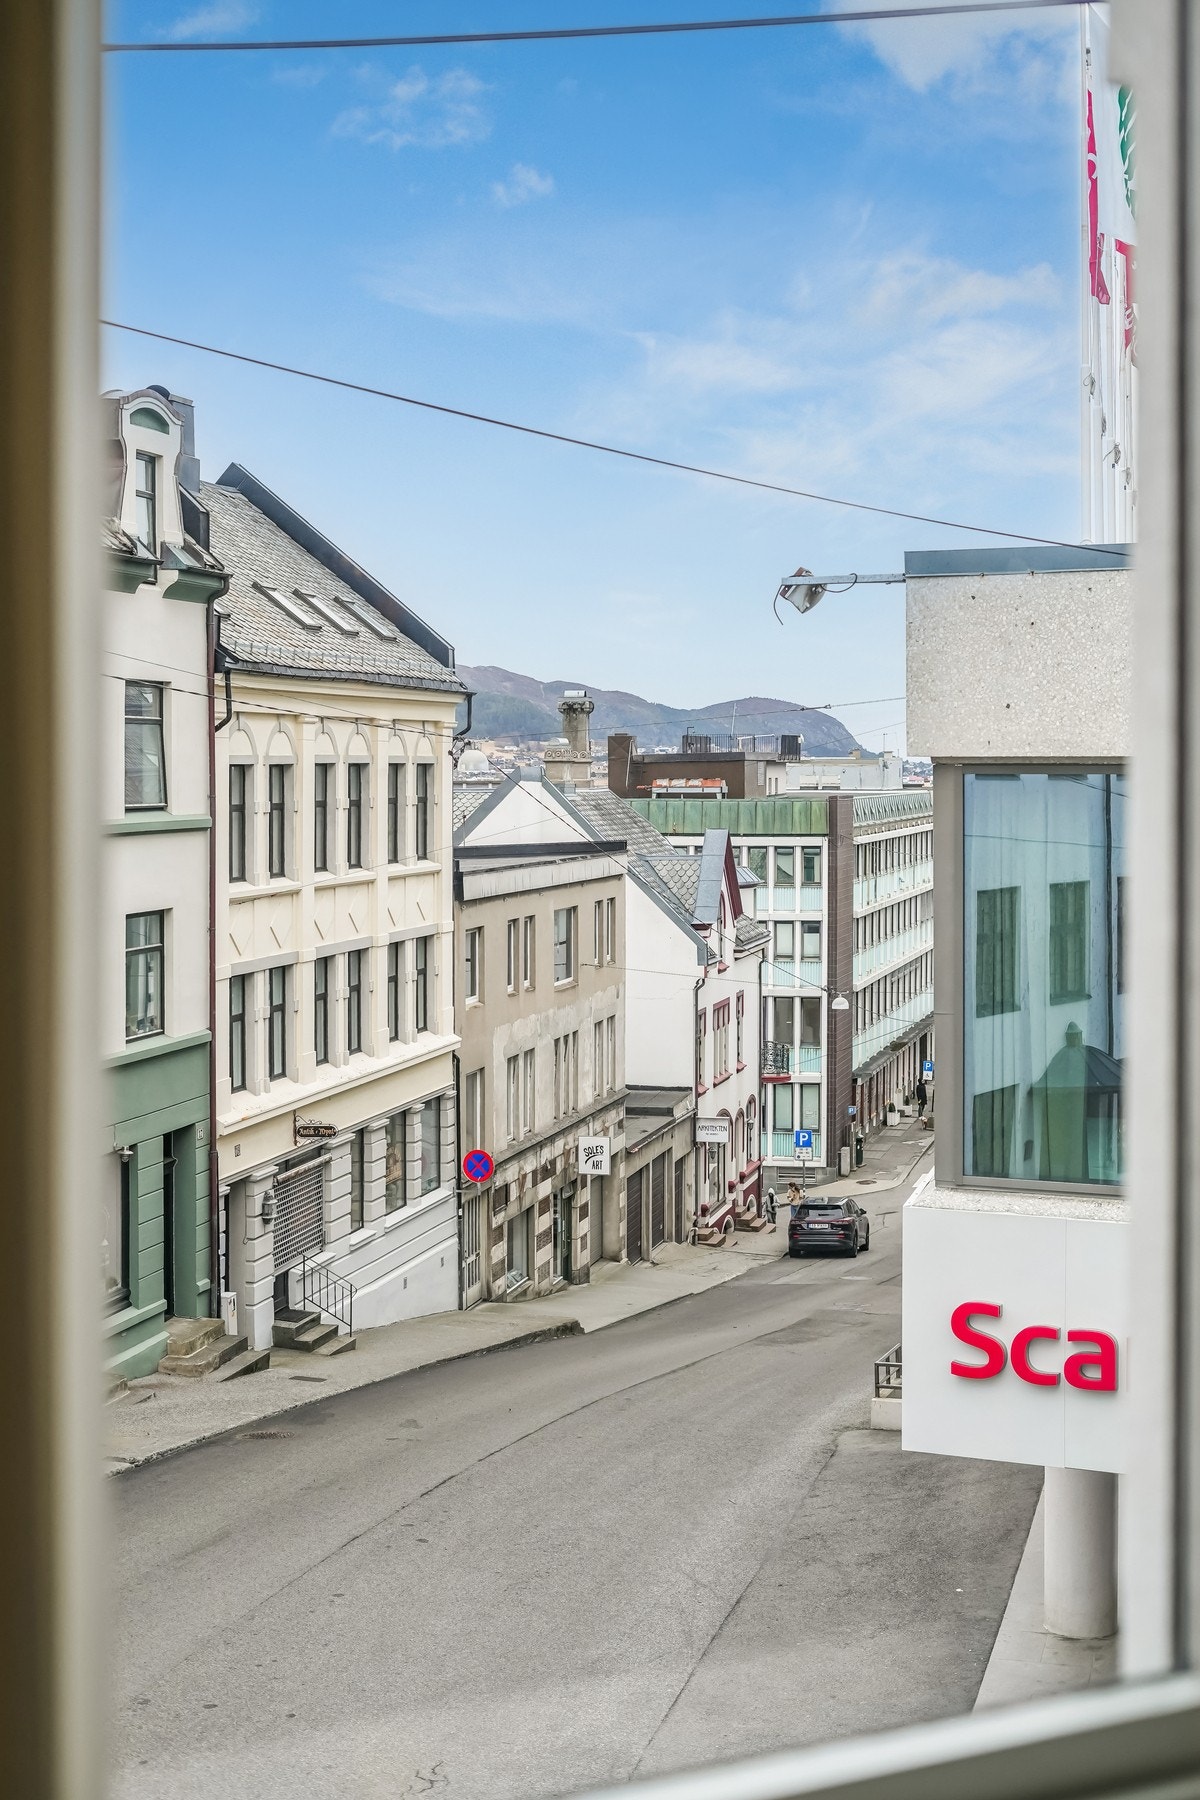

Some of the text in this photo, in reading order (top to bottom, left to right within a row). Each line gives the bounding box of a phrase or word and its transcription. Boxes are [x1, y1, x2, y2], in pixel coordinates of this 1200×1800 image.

[299, 1127, 315, 1135] Antik
[800, 1133, 808, 1145] P
[592, 1160, 603, 1170] ART
[951, 1301, 1128, 1392] Sca
